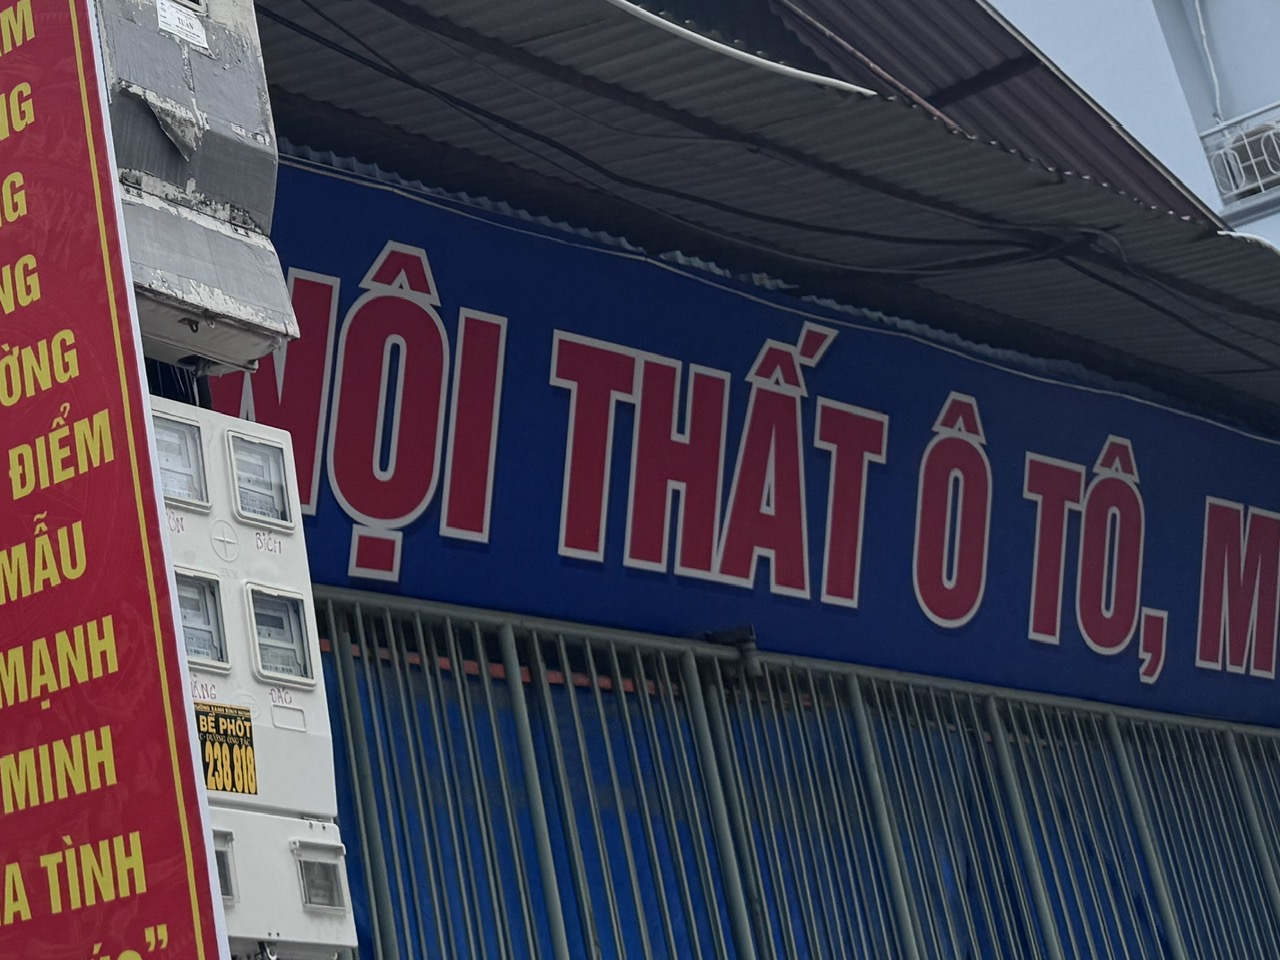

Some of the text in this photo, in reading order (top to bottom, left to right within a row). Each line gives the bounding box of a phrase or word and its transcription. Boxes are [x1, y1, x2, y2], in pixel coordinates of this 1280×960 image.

[8, 402, 116, 502] ĐIỂM
[209, 239, 1280, 685] NỘI THẤT Ô TÔ, M
[0, 724, 118, 815] MINH
[219, 717, 251, 738] PHỐT
[39, 830, 148, 916] TÌNH
